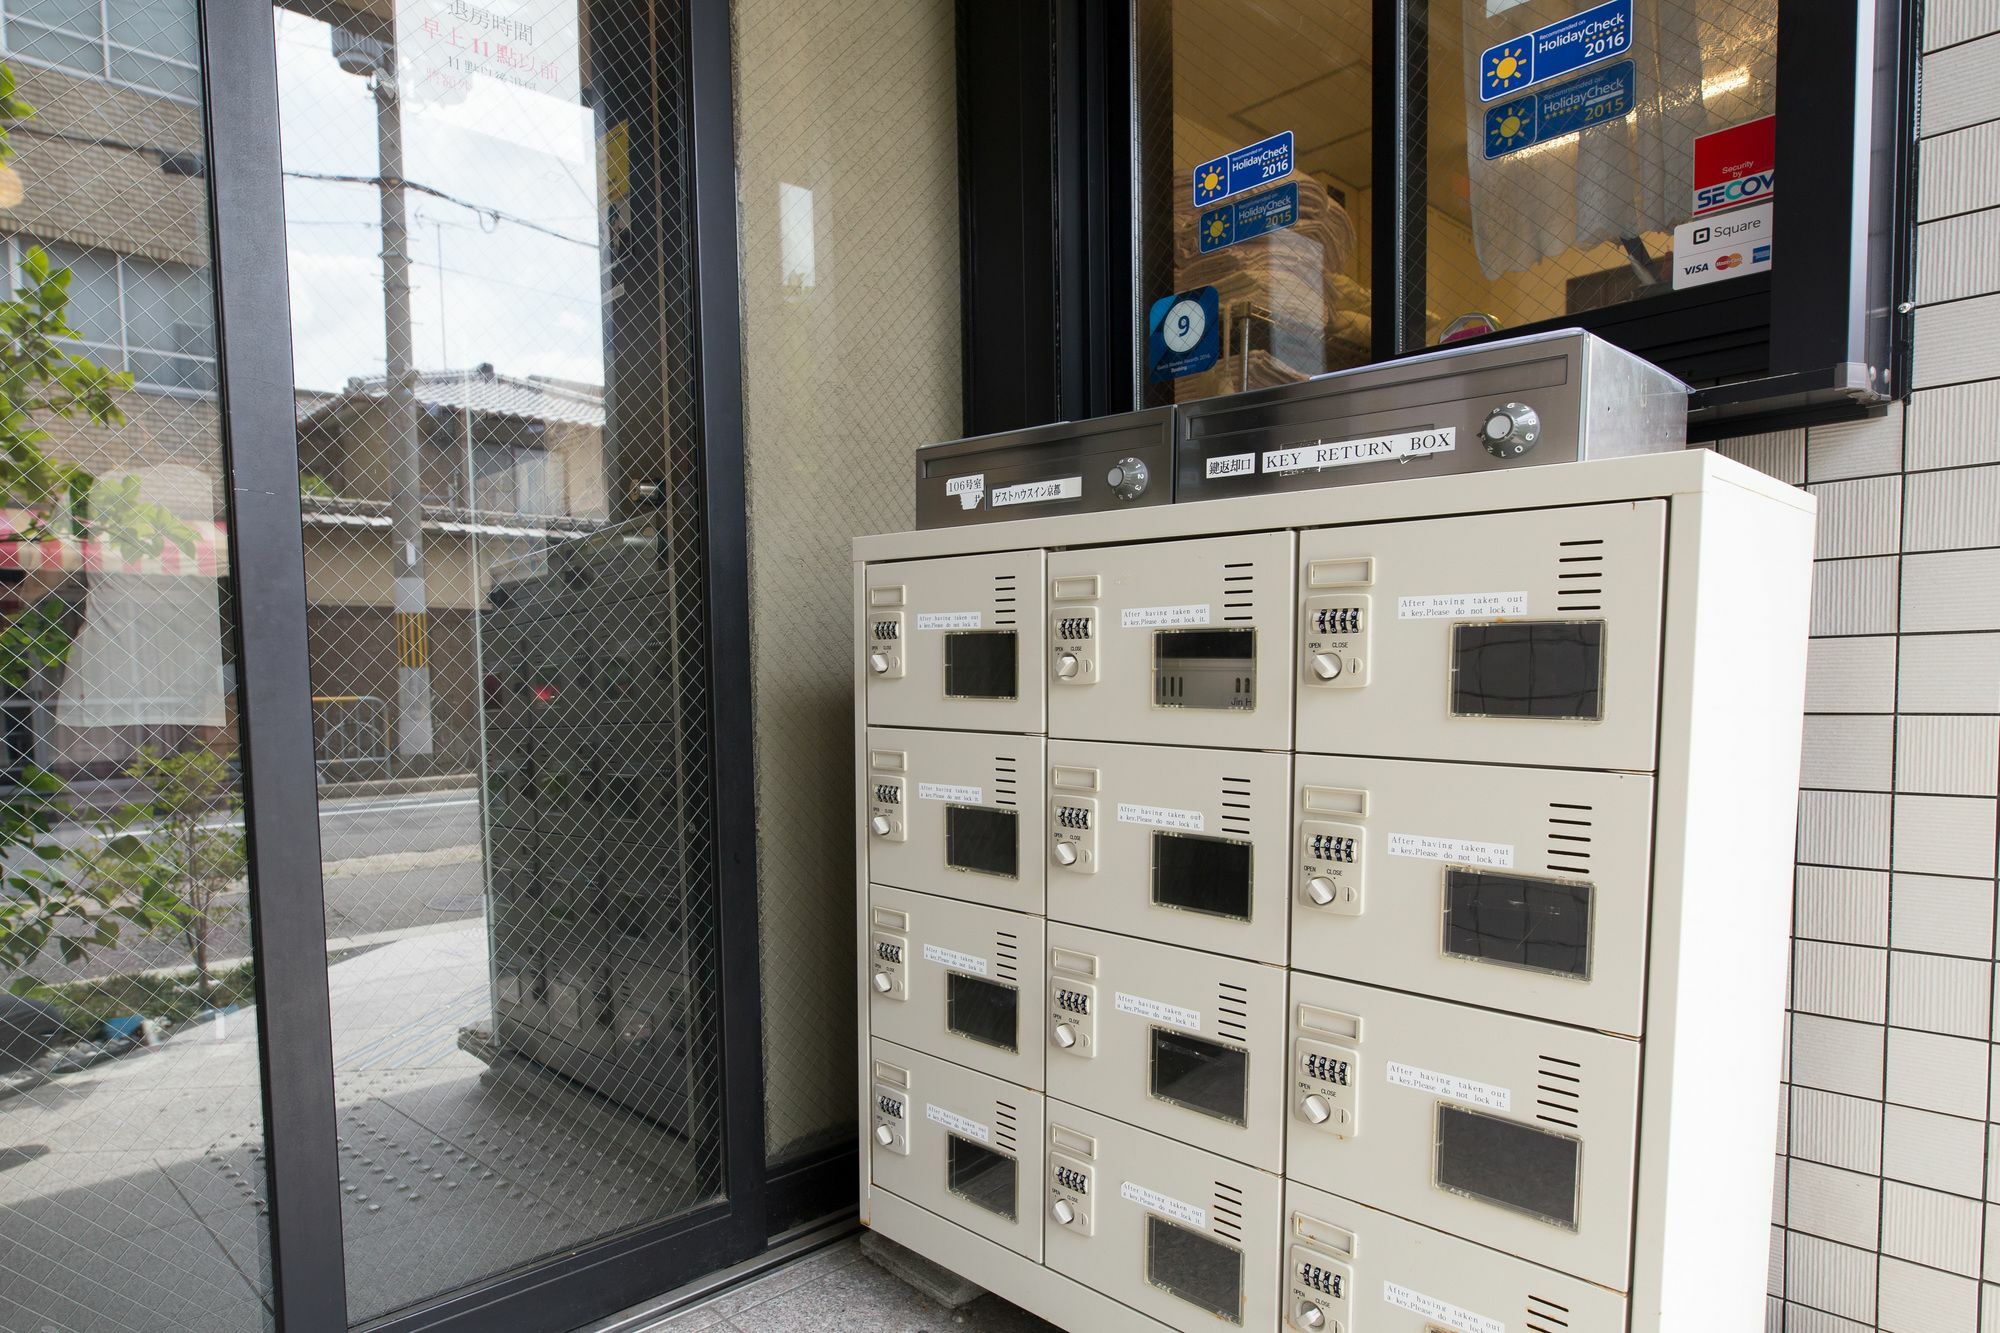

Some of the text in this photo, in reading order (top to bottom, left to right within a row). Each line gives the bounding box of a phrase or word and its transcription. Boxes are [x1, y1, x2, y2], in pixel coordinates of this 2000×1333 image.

[447, 0, 533, 46] 退房時間
[1539, 12, 1625, 54] HolidayCheck
[423, 16, 466, 49] 早上
[473, 38, 489, 57] 11
[497, 43, 559, 82] 點以前
[1584, 31, 1625, 58] 2016
[1544, 78, 1624, 114] HolidayCheck
[1585, 96, 1624, 121] 2015
[1232, 144, 1288, 172] HolidayCheck
[1722, 160, 1754, 175] Security
[1262, 159, 1288, 178] 2016
[1732, 170, 1743, 178] by
[1238, 195, 1291, 220] HolidayCheck
[1265, 211, 1291, 228] 2015
[1714, 219, 1761, 238] Square
[1683, 263, 1709, 275] VISA
[1178, 315, 1190, 338] 9
[1266, 432, 1450, 469] KEY RETURN BOX
[1209, 458, 1251, 475] 鍵返却口
[949, 478, 982, 492] 106号室
[994, 483, 1061, 504] ゲストハウスイン京都
[1433, 598, 1465, 606] having
[1473, 596, 1499, 604] taken
[1506, 595, 1523, 603] out
[1489, 606, 1506, 614] lock
[1391, 836, 1509, 856] After having taken out
[1476, 855, 1493, 864] lock
[1326, 868, 1343, 876] CLOSE
[1298, 1081, 1337, 1097] OPEN CLOSE
[1390, 1064, 1506, 1099] After having taken out
[1441, 1087, 1451, 1095] do
[1456, 1091, 1468, 1099] not
[1474, 1094, 1490, 1105] lock
[1293, 1288, 1331, 1308] OPEN CLOSE
[1387, 1285, 1500, 1332] After having taken out
[1437, 1313, 1447, 1321] do
[1451, 1318, 1464, 1328] not
